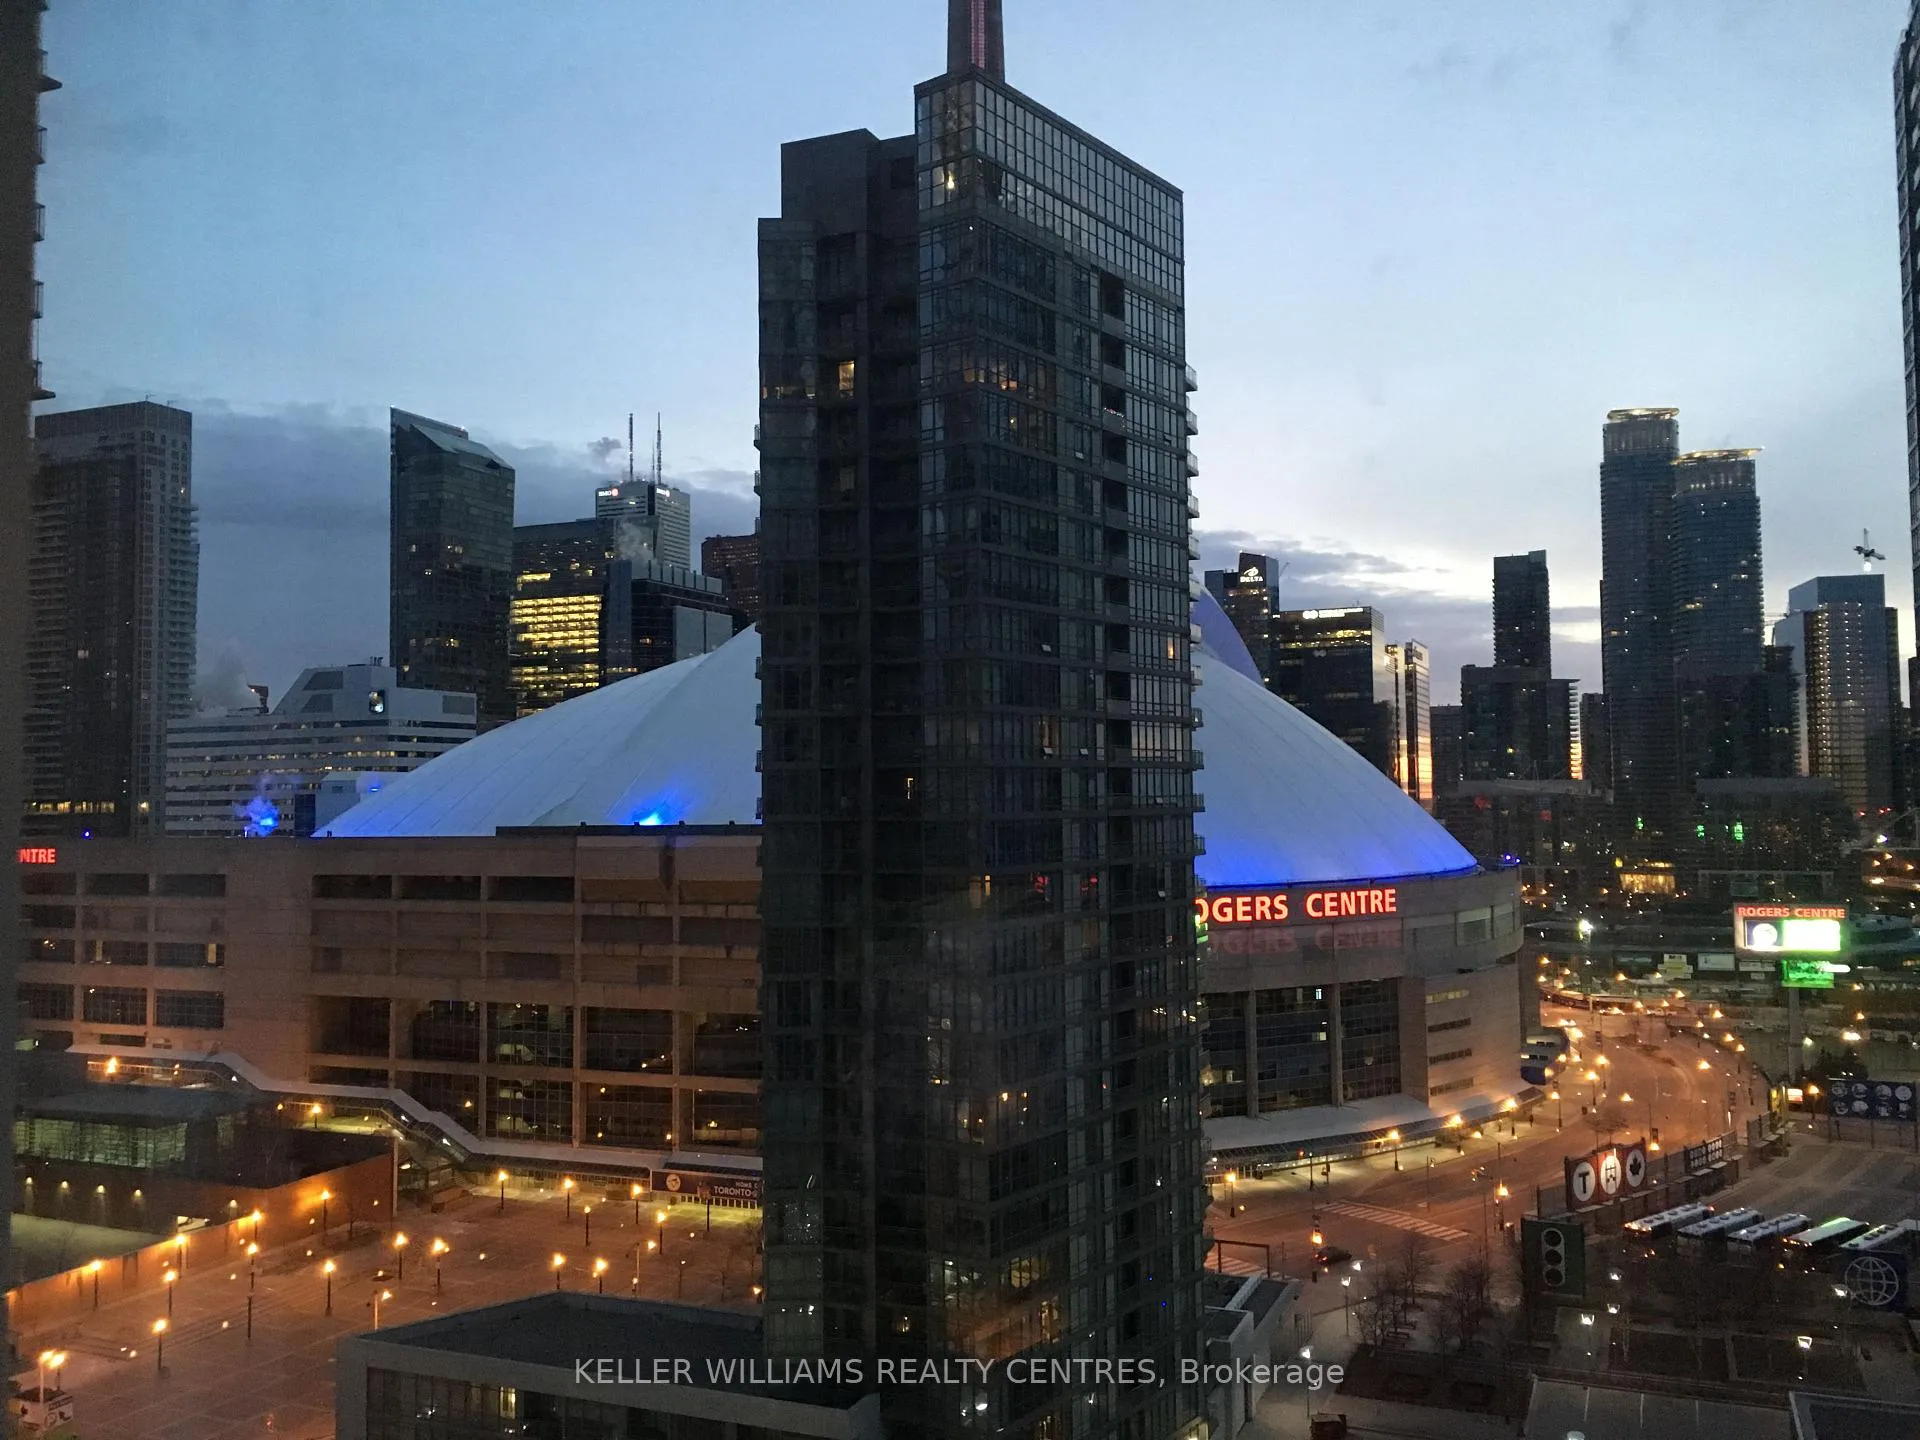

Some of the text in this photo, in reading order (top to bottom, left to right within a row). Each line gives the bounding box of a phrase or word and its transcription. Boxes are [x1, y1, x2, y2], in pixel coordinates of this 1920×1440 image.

[1306, 888, 1397, 918] CENTRE
[1738, 907, 1845, 918] ROGERS CENTRE
[714, 1185, 751, 1197] TORONTO
